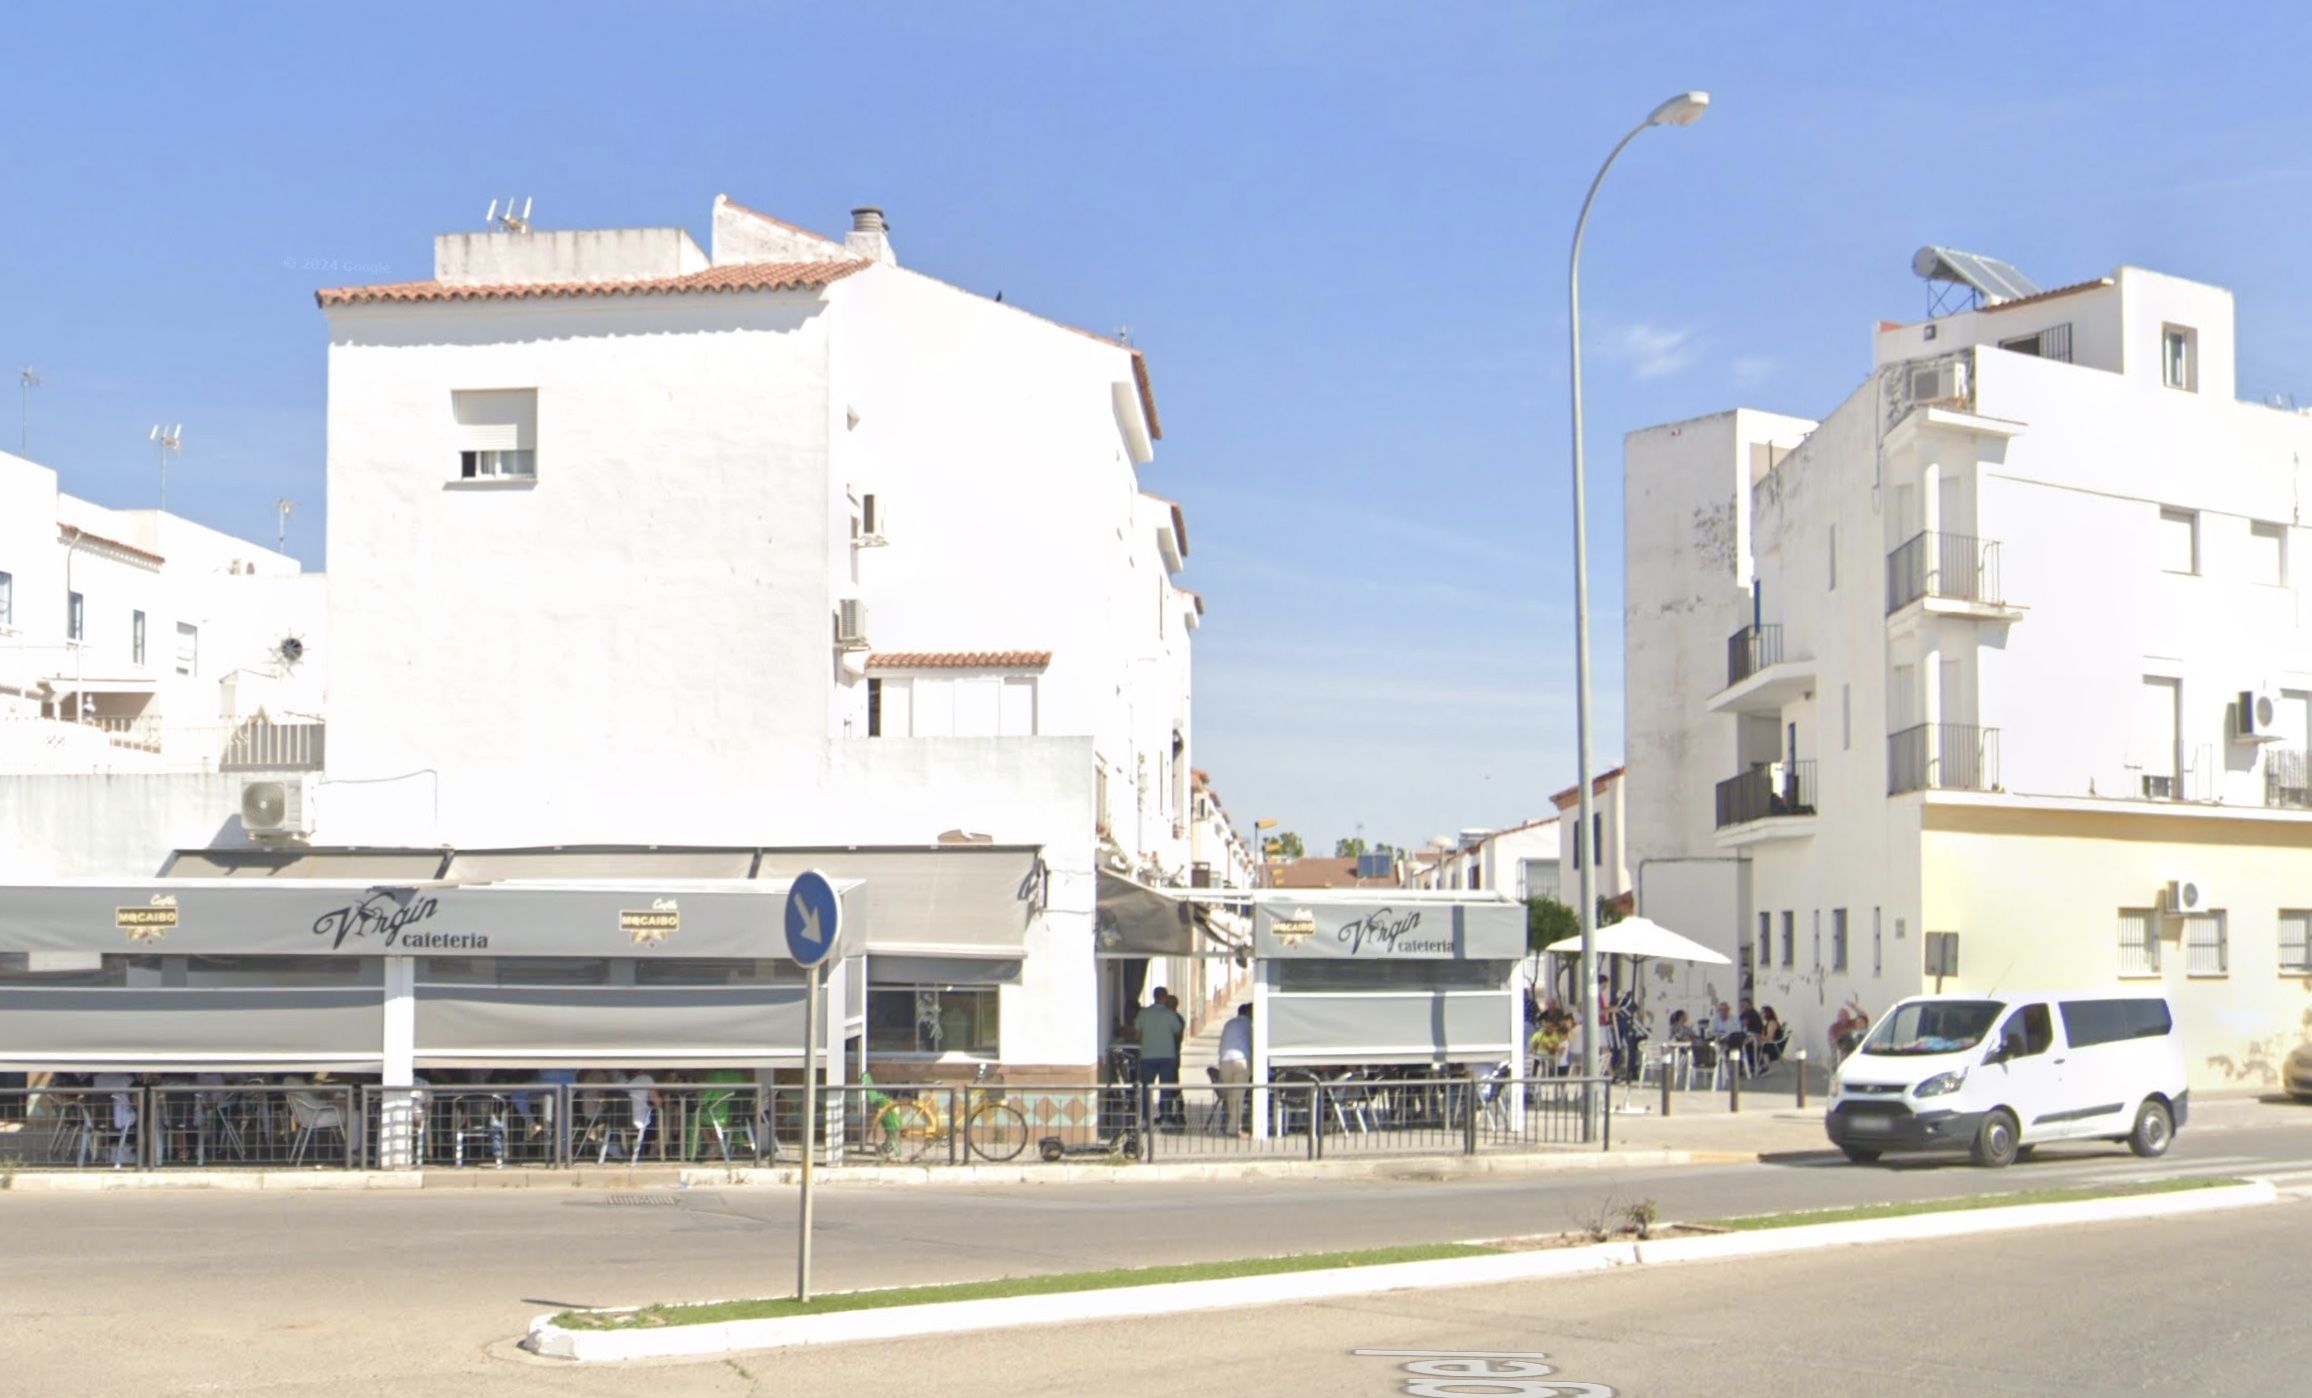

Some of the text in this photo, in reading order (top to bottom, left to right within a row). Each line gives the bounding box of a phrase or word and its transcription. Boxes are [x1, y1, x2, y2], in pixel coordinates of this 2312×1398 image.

[312, 892, 438, 950] Virgin
[1337, 907, 1421, 955] Virgin
[401, 931, 489, 949] cafeteria
[1398, 940, 1455, 953] cafeteria
